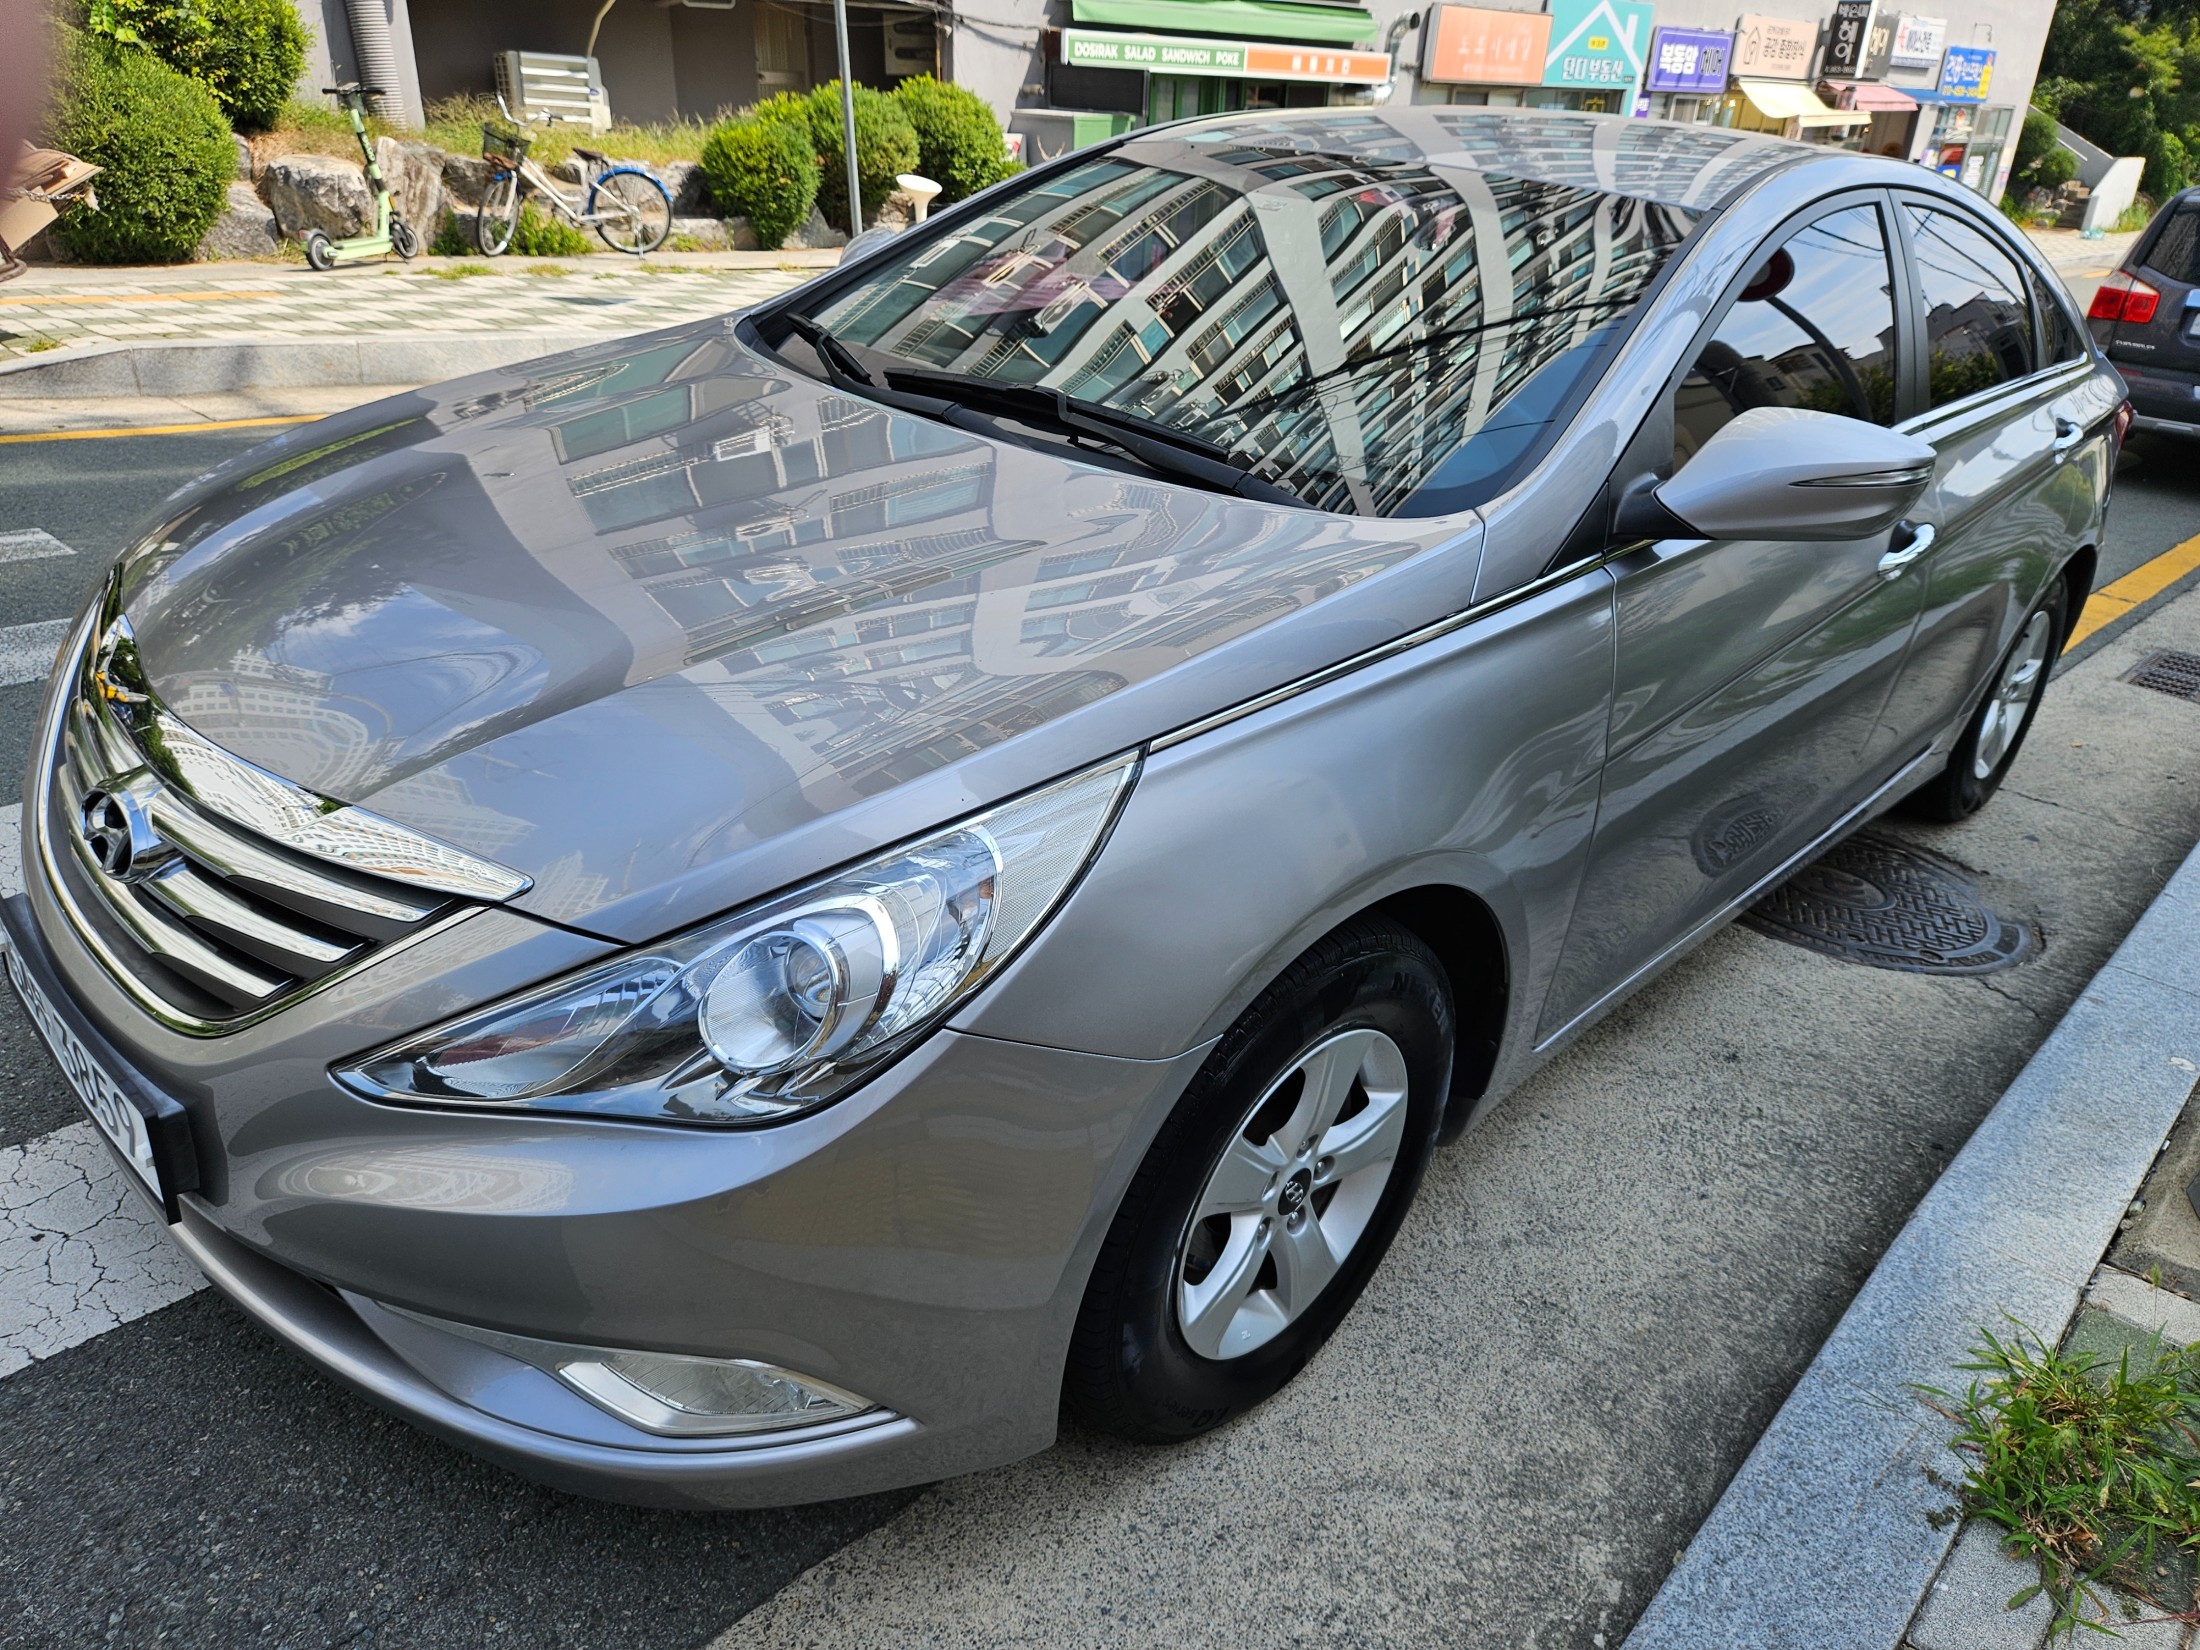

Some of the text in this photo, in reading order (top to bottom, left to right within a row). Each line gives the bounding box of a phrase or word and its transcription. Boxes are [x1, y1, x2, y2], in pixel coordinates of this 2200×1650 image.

[1074, 42, 1240, 66] DOSIRAK SALAD SANDWICH POKE
[1390, 971, 1449, 1037] NXEN
[53, 1010, 136, 1159] 3859
